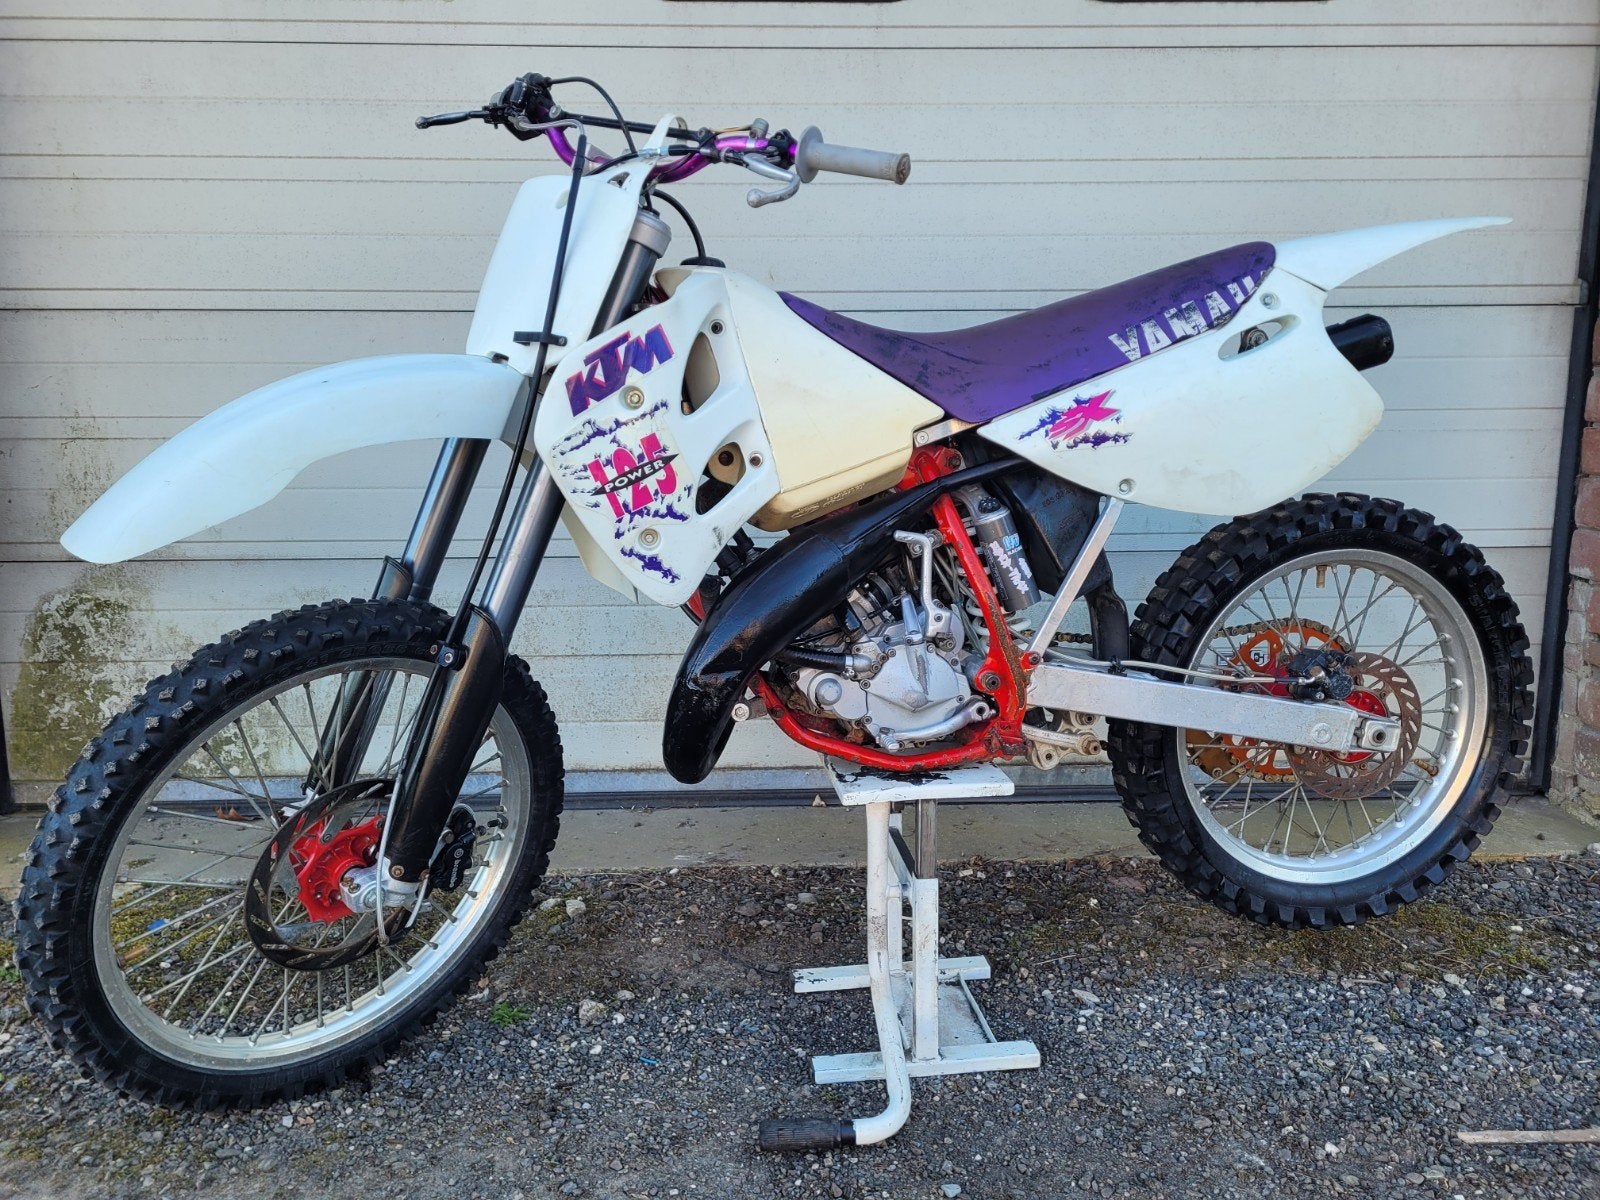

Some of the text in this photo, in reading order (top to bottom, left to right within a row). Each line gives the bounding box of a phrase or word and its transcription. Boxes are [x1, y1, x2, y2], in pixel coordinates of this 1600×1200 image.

[1108, 270, 1266, 362] YAMAH
[565, 323, 675, 417] KTM
[587, 432, 677, 519] 125
[604, 459, 665, 493] POWER
